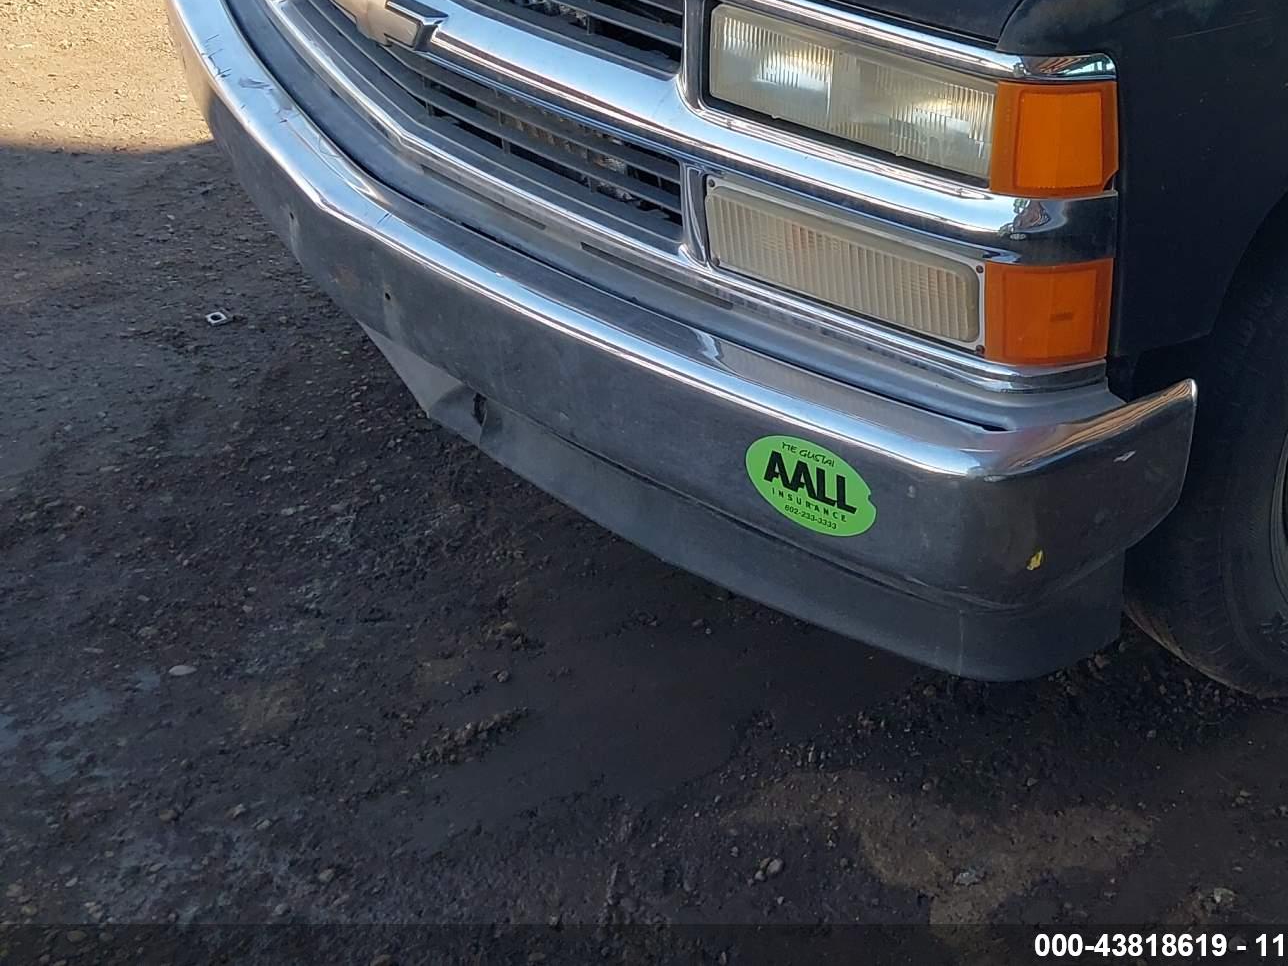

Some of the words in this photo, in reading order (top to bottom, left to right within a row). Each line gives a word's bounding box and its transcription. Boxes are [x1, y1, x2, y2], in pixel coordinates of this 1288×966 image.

[781, 441, 798, 454] ME
[763, 450, 858, 515] AALL
[771, 487, 848, 523] INSURANCE
[784, 504, 838, 530] 602-233-3333
